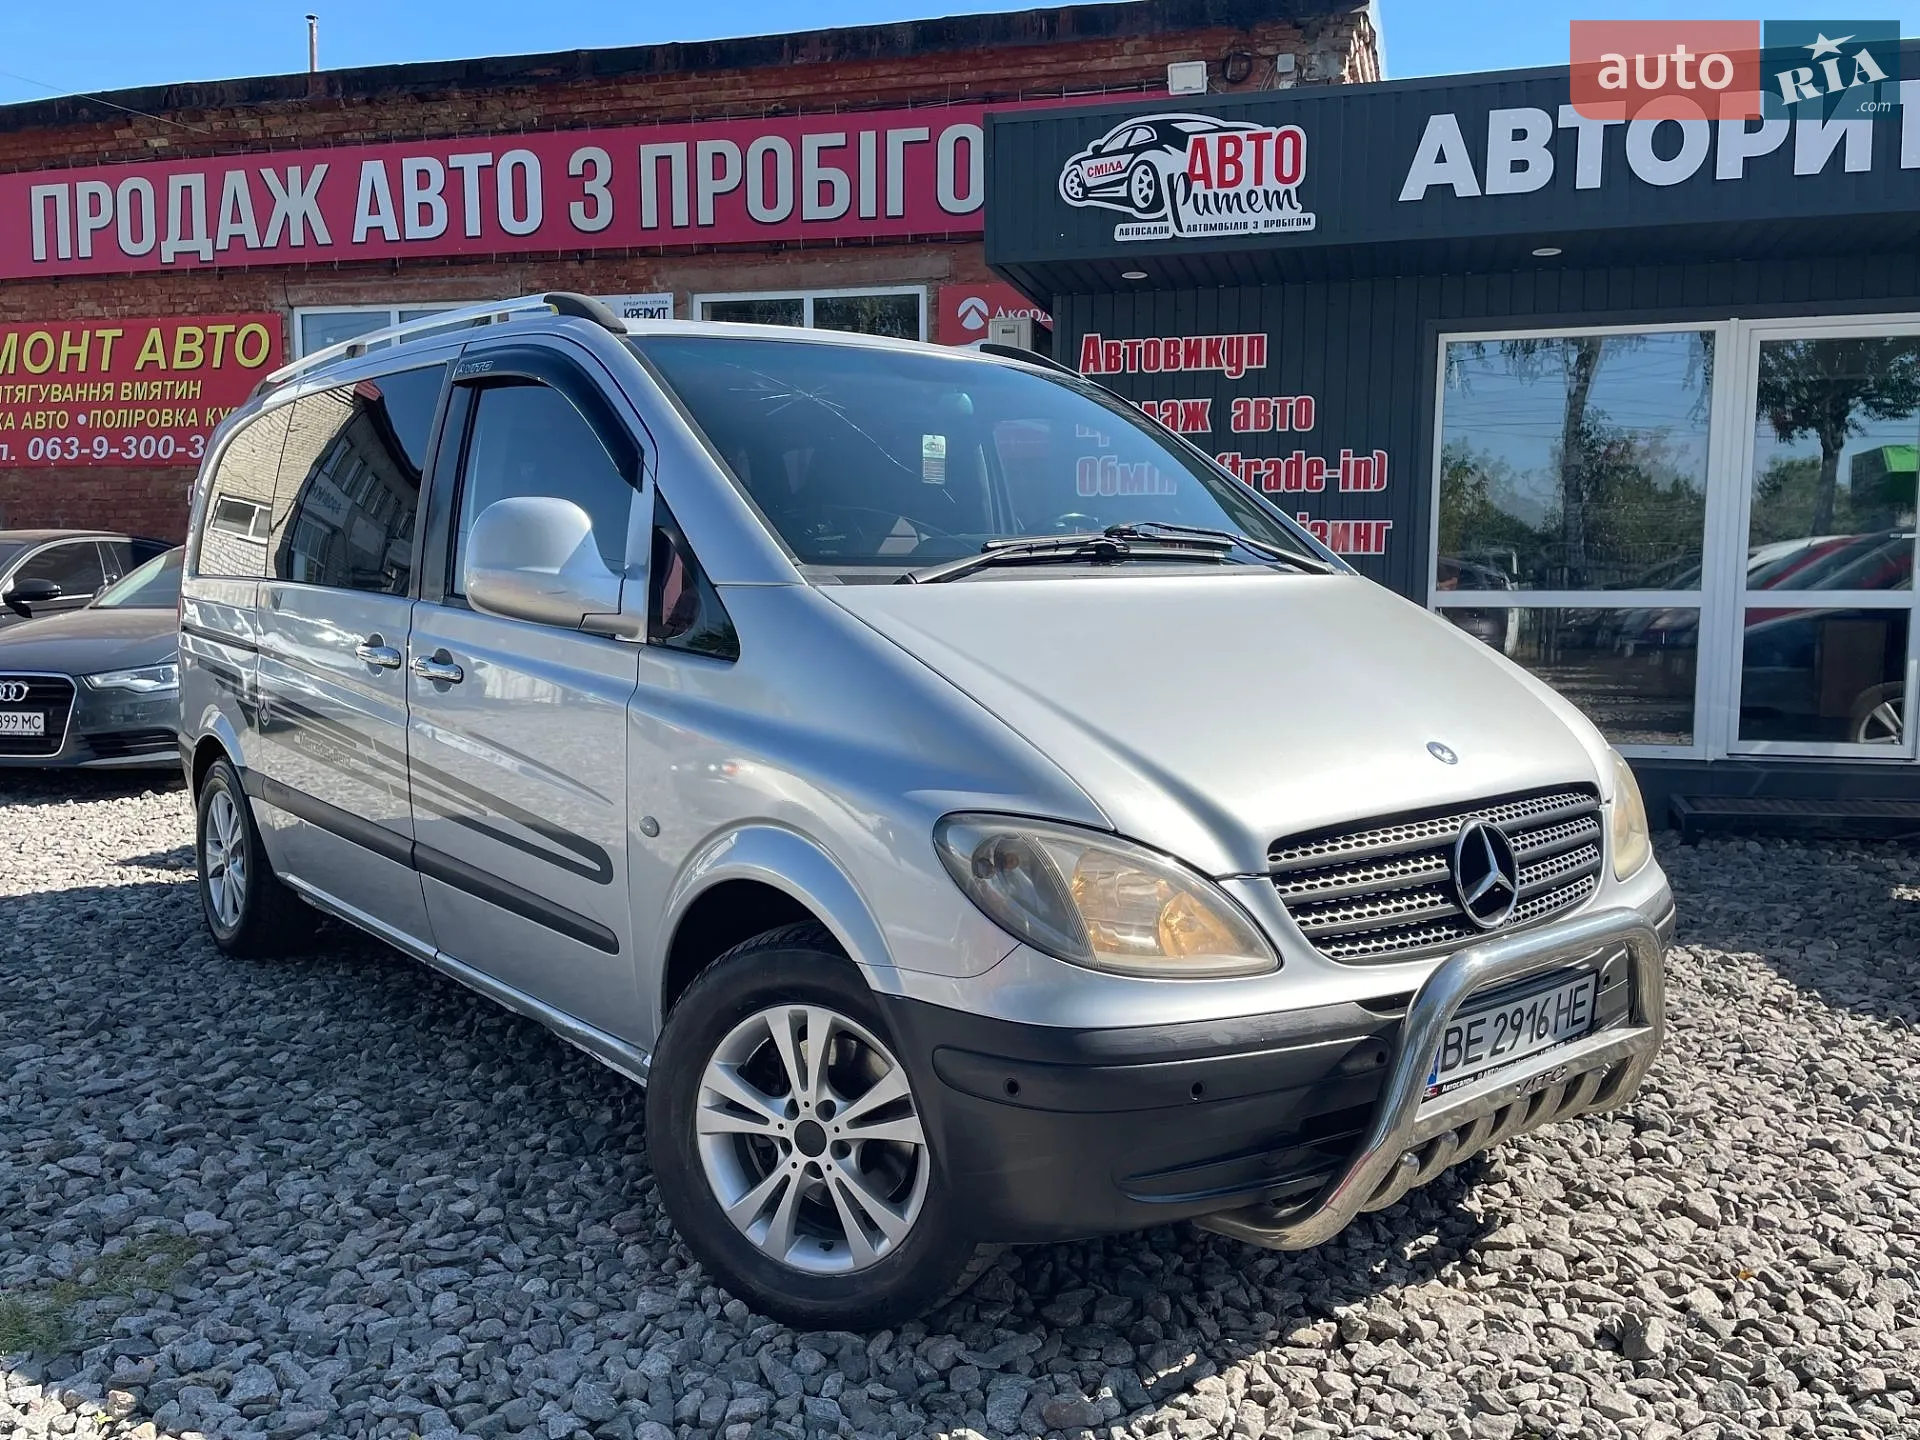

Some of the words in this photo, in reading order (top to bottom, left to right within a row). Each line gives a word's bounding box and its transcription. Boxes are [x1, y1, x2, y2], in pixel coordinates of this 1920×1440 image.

[1086, 160, 1123, 178] СМІЛА
[1187, 129, 1301, 190] АВТО
[30, 163, 333, 264] ПРОДАЖ
[352, 149, 544, 244] АВТО
[568, 146, 615, 233] З
[639, 123, 984, 230] ПРОБІГО
[1118, 225, 1170, 237] АВТОСАЛОН
[1186, 221, 1249, 233] АВТОМОБІЛІВ
[1263, 217, 1312, 229] ПРОБІГОМ
[135, 323, 270, 371] АВТО
[1079, 333, 1268, 379] Автовикуп
[120, 380, 202, 401] ВМЯТИН
[21, 410, 69, 430] АВТО
[89, 407, 199, 429] ПОЛІРОВКА
[205, 407, 238, 427] КУ
[1231, 395, 1315, 433] авто
[28, 434, 204, 462] 063-9-300-3
[22, 715, 41, 729] MC
[1441, 1018, 1487, 1073] BE
[1489, 996, 1551, 1056] 2916
[1554, 983, 1589, 1033] HE
